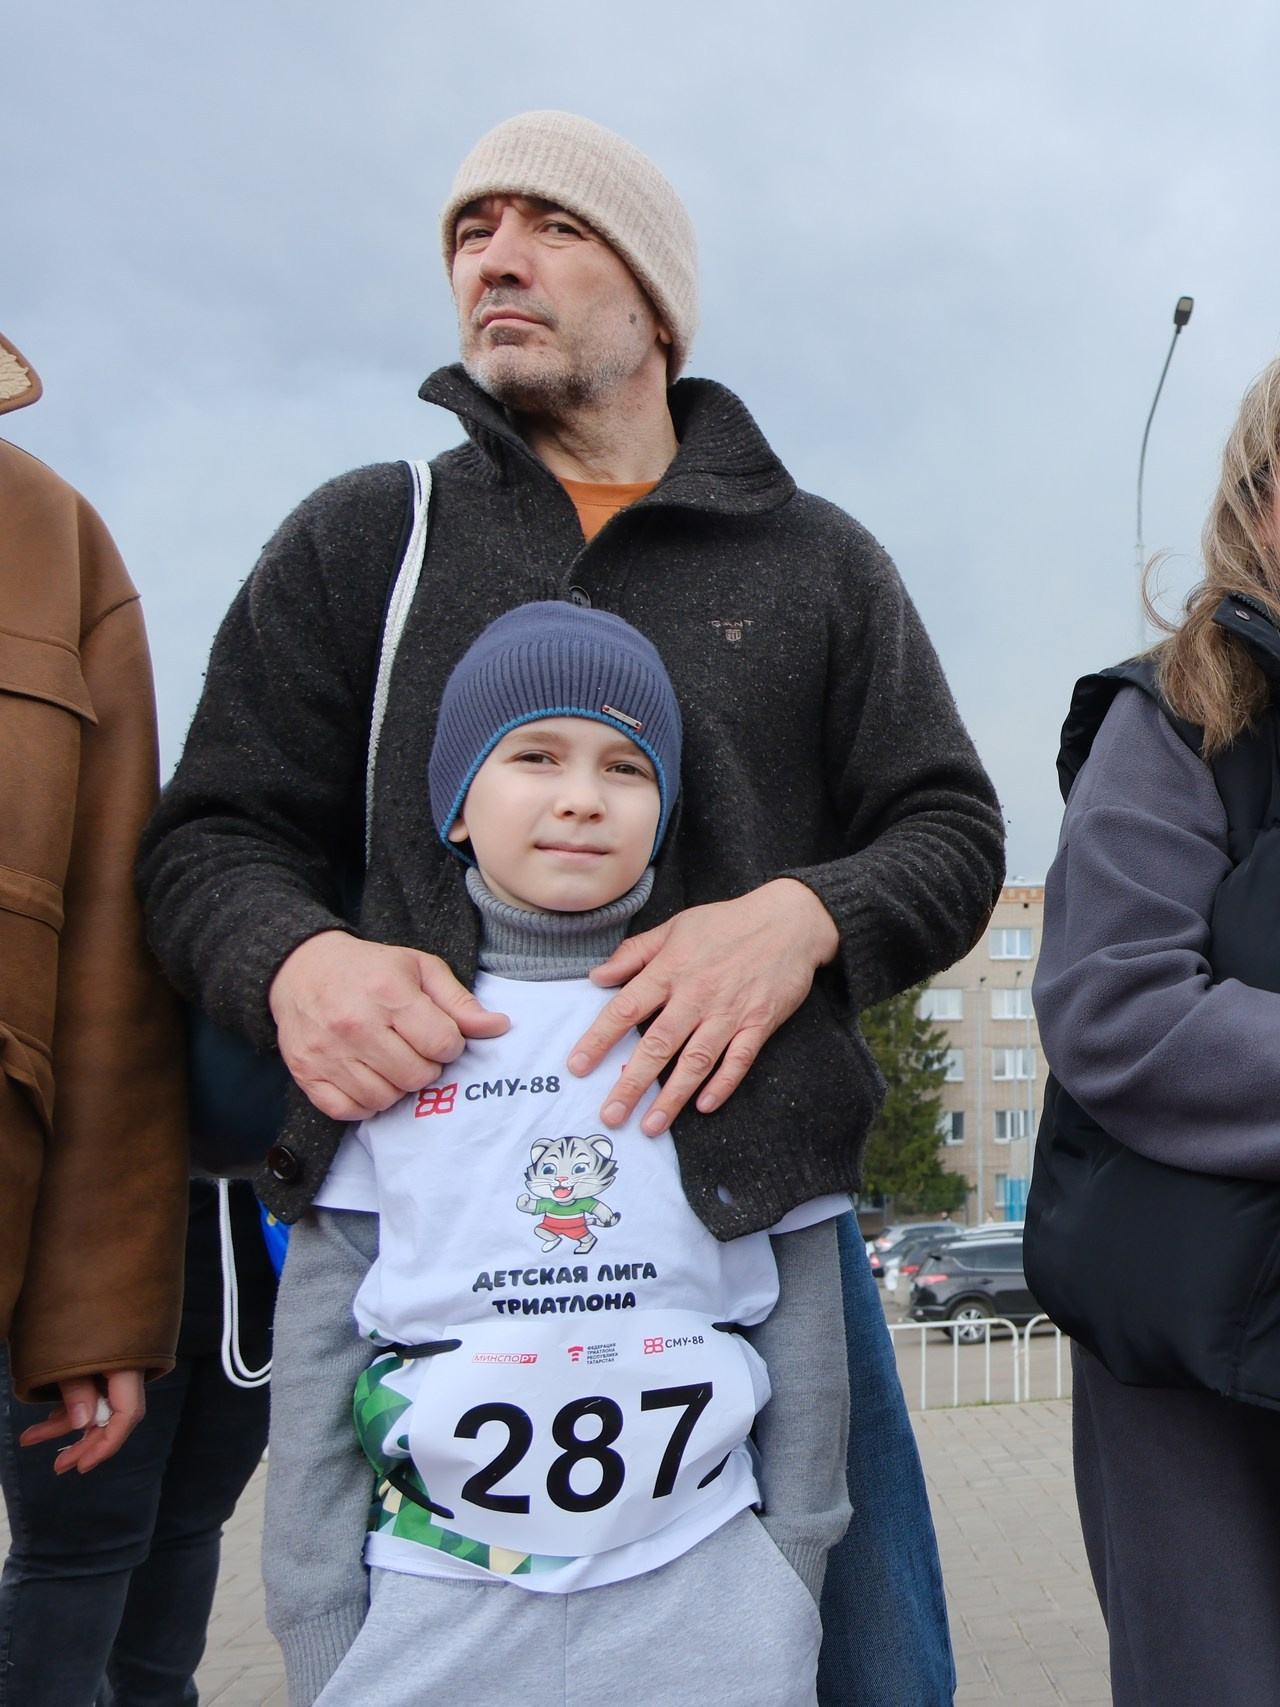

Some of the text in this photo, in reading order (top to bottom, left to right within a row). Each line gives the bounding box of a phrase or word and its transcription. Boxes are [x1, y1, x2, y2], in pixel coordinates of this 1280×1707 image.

[711, 619, 755, 628] GANT
[465, 1075, 561, 1101] СМУ-88
[472, 1262, 658, 1293] ДЕТСКАЯ ЛИГА
[491, 1291, 637, 1316] ТРИАТЛОНА
[665, 1335, 705, 1349] СМУ-88
[473, 1353, 538, 1363] МИНСПОРТ
[453, 1381, 714, 1514] 287
